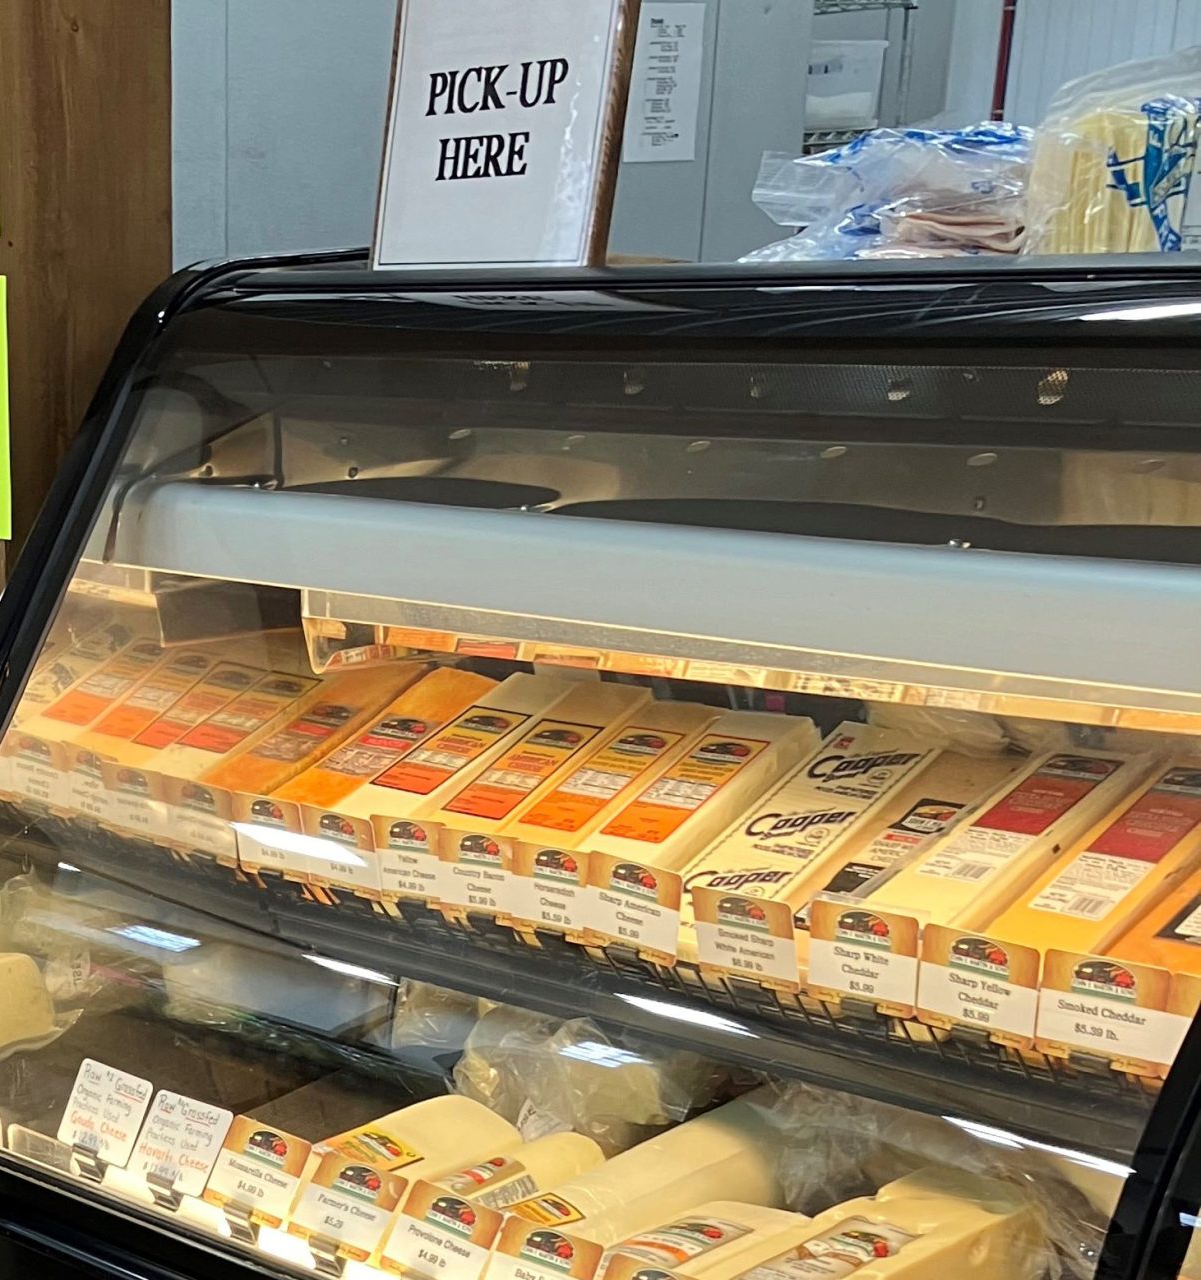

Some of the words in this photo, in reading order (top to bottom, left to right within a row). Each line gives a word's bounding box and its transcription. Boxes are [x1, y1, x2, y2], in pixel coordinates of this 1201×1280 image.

[425, 57, 569, 117] PICK-UP
[435, 131, 531, 182] HERE
[807, 753, 921, 780] Cooper
[745, 810, 857, 837] Cooper
[833, 946, 861, 960] Sharp
[863, 952, 889, 966] White
[841, 963, 880, 979] Cheddar
[948, 972, 979, 989] Sharp
[981, 981, 1012, 997] Yellow
[958, 991, 1000, 1010] Cheddar
[1057, 999, 1100, 1017] Smoked
[1101, 1008, 1147, 1026] Cheddar
[263, 1173, 288, 1189] Cheese
[317, 1193, 349, 1212] Farmer's
[350, 1206, 377, 1222] Cheese
[407, 1224, 443, 1247] Provolone
[443, 1240, 471, 1259] Cheese
